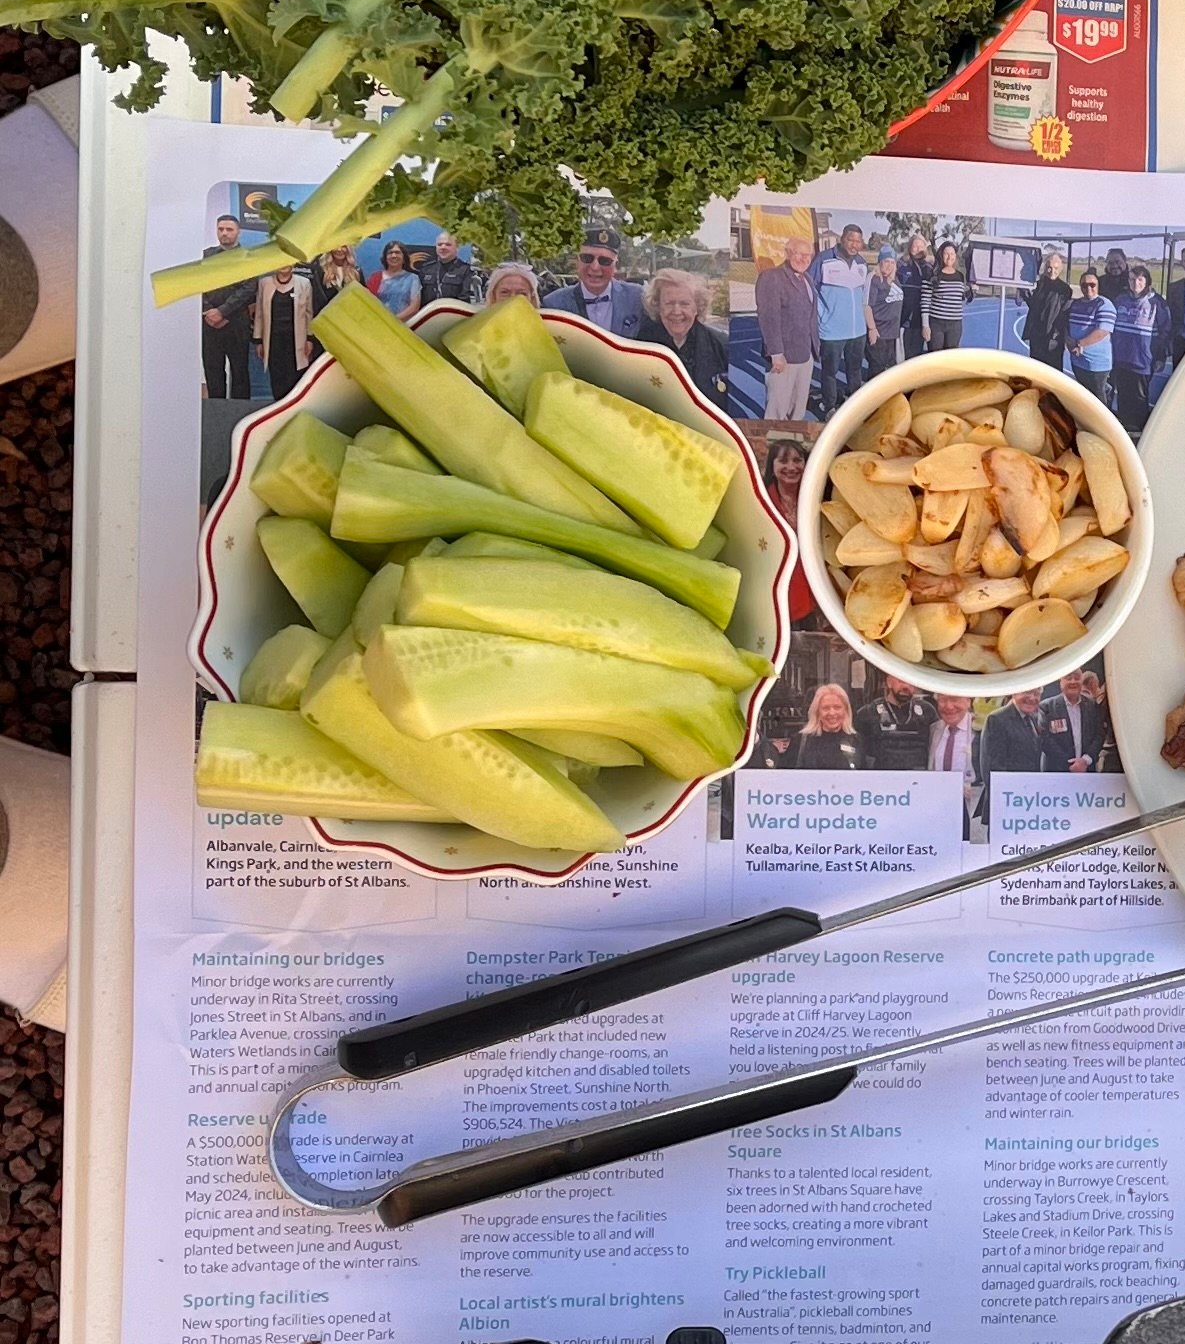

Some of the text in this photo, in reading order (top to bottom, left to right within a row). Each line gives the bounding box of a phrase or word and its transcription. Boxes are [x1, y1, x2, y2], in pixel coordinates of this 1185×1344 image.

[1068, 85, 1108, 98] Supports
[1071, 98, 1104, 111] healthy
[1067, 111, 1107, 122] digestion
[747, 789, 910, 805] Horseshoe Bend
[1002, 791, 1125, 811] Taylors Ward
[747, 813, 876, 833] Ward update
[746, 843, 936, 855] Kealba, Keilor Park, Keilor East,
[192, 951, 383, 968] Maintaining our bridges
[988, 949, 1153, 965] Concrete path upgrade
[725, 1265, 825, 1283] Try Pickleball
[183, 1289, 328, 1309] Sporting facilities
